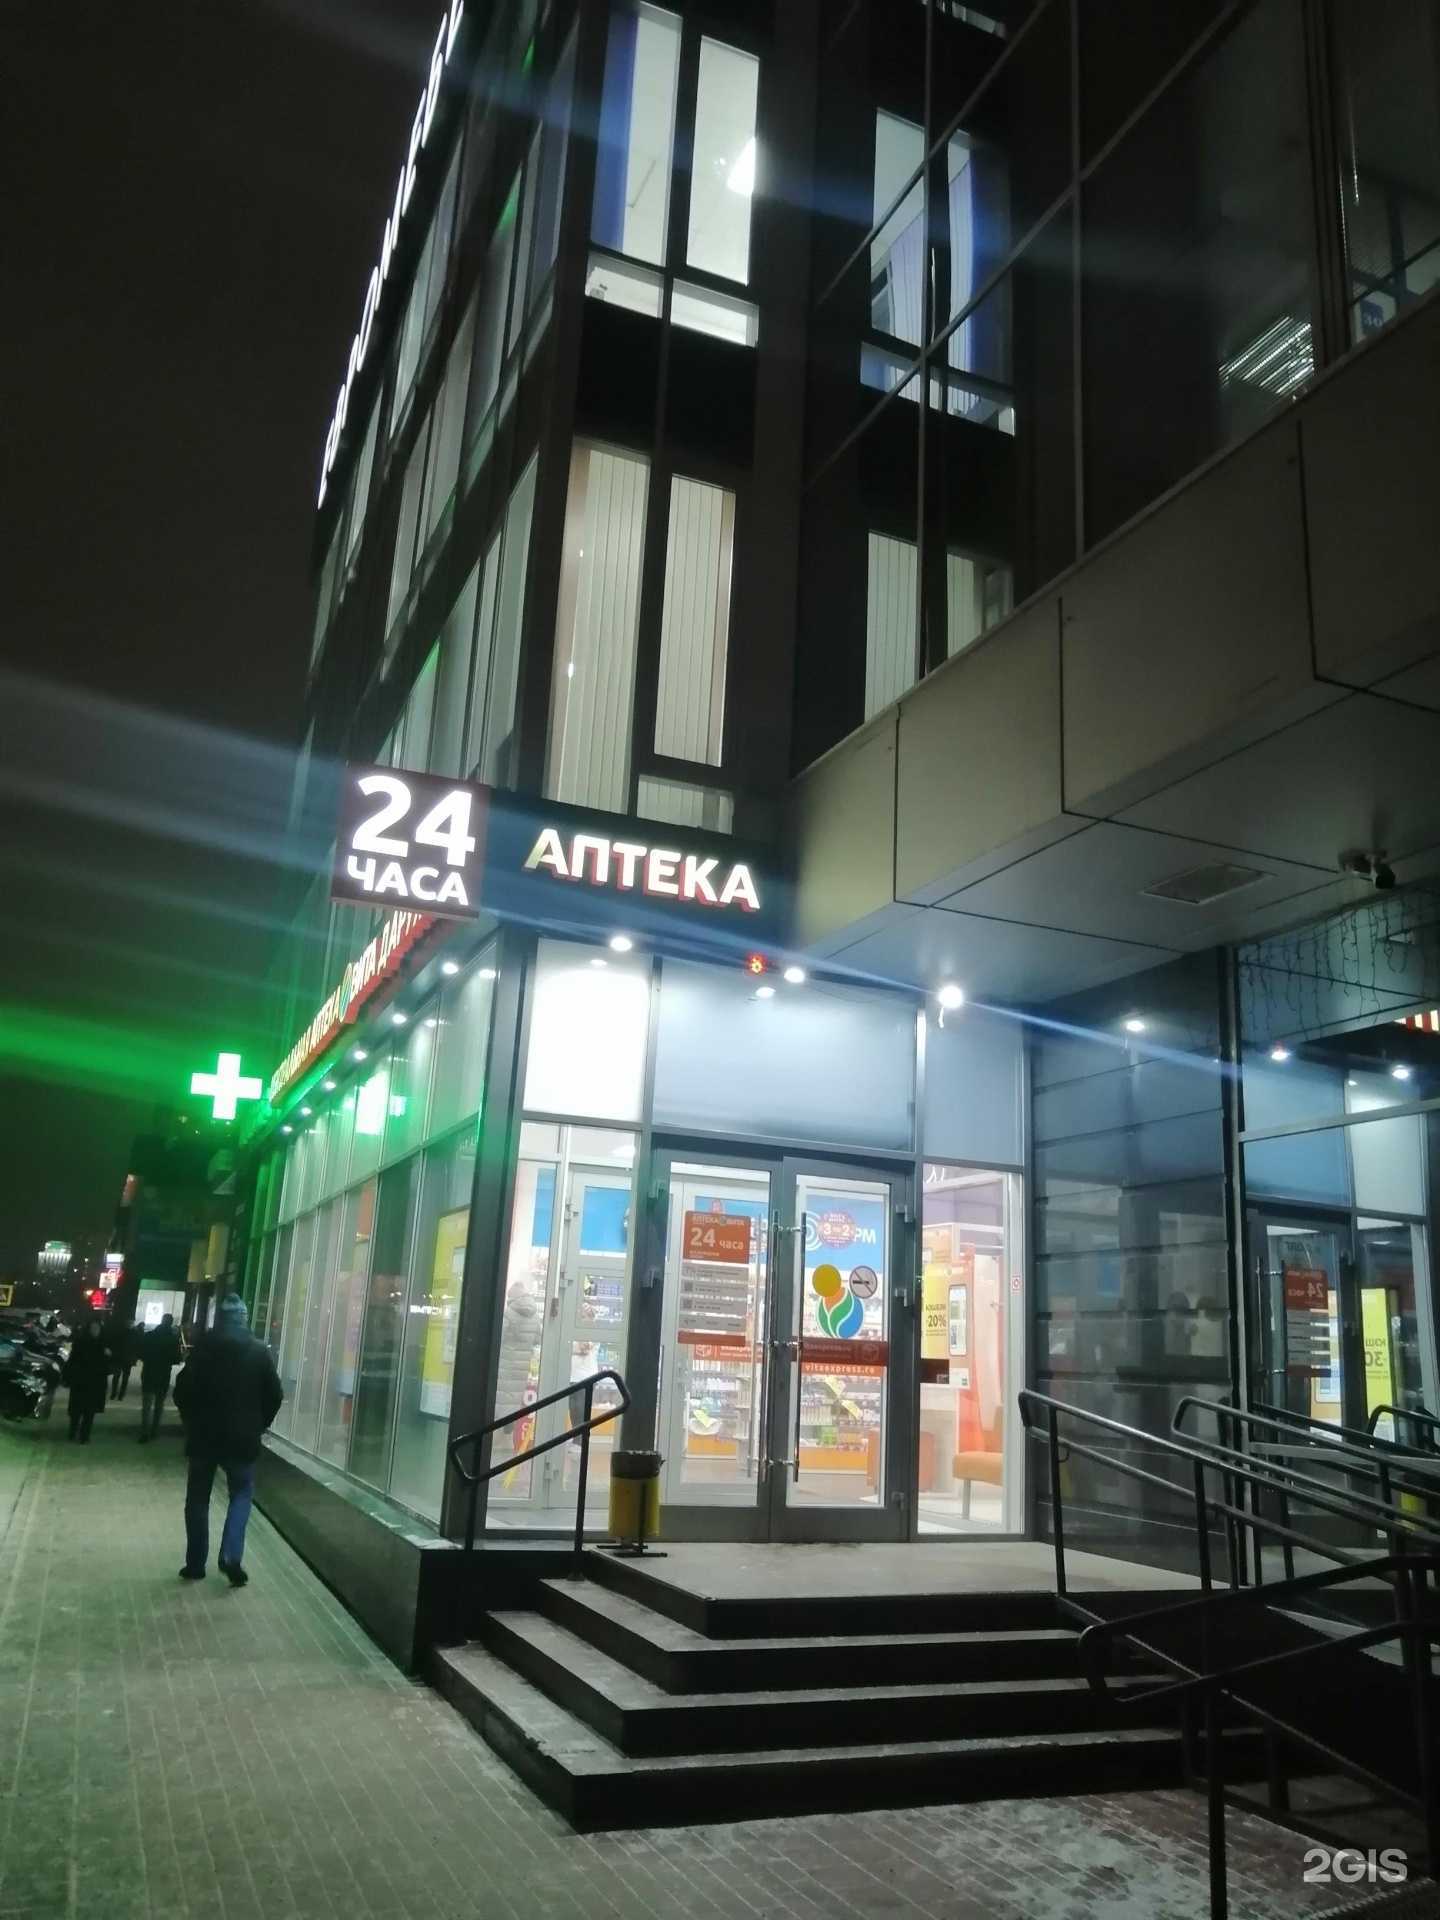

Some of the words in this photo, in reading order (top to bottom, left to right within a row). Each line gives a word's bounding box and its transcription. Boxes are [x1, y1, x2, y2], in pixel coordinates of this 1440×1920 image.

[351, 775, 476, 867] 24
[346, 856, 469, 907] ЧАСА
[523, 828, 761, 912] АПТЕКА
[690, 1227, 716, 1247] 24
[719, 1240, 744, 1250] часа
